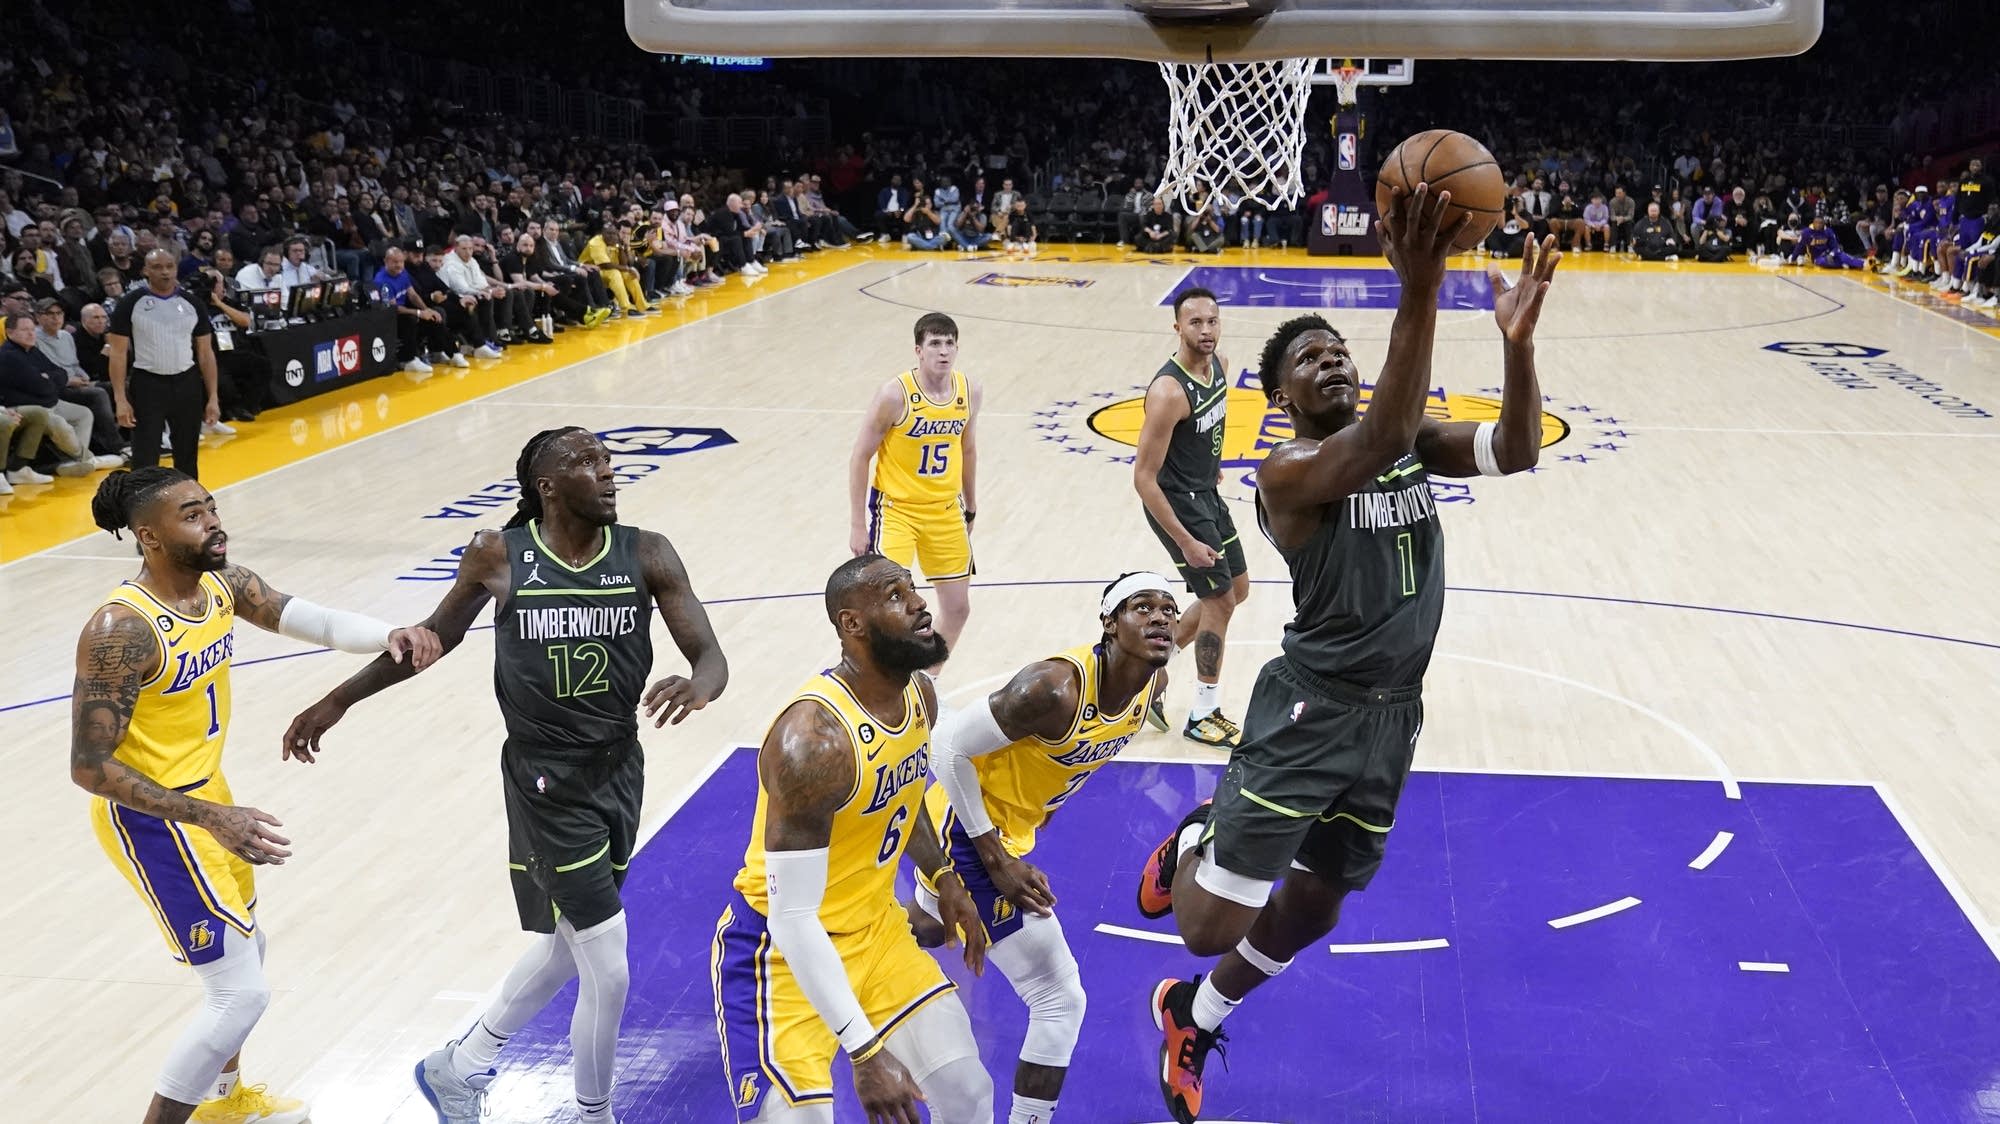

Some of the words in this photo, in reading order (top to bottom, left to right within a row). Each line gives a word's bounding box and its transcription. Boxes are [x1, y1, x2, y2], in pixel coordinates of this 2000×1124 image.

[716, 56, 763, 65] EXPRESS
[1338, 213, 1370, 227] PLAY-IN
[317, 349, 333, 374] NBA
[341, 351, 358, 362] TNT
[372, 344, 386, 354] TNT
[286, 367, 304, 380] TNT
[1800, 360, 1878, 389] ARENA
[912, 394, 920, 403] 6
[1862, 361, 1993, 418] crypto.com
[905, 416, 966, 437] LAKERS
[1211, 424, 1223, 456] 5
[918, 443, 949, 475] 15
[422, 478, 521, 519] ENA
[523, 550, 534, 563] 6
[1397, 532, 1417, 596] 1
[161, 617, 172, 630] 6
[516, 605, 637, 644] TIMBERWOLVES
[547, 642, 609, 698] 12
[205, 682, 220, 738] 1
[1085, 706, 1095, 719] 6
[860, 727, 873, 741] 6
[1048, 732, 1134, 767] LAKERS
[861, 742, 929, 816] LAKERS
[877, 804, 908, 866] 6
